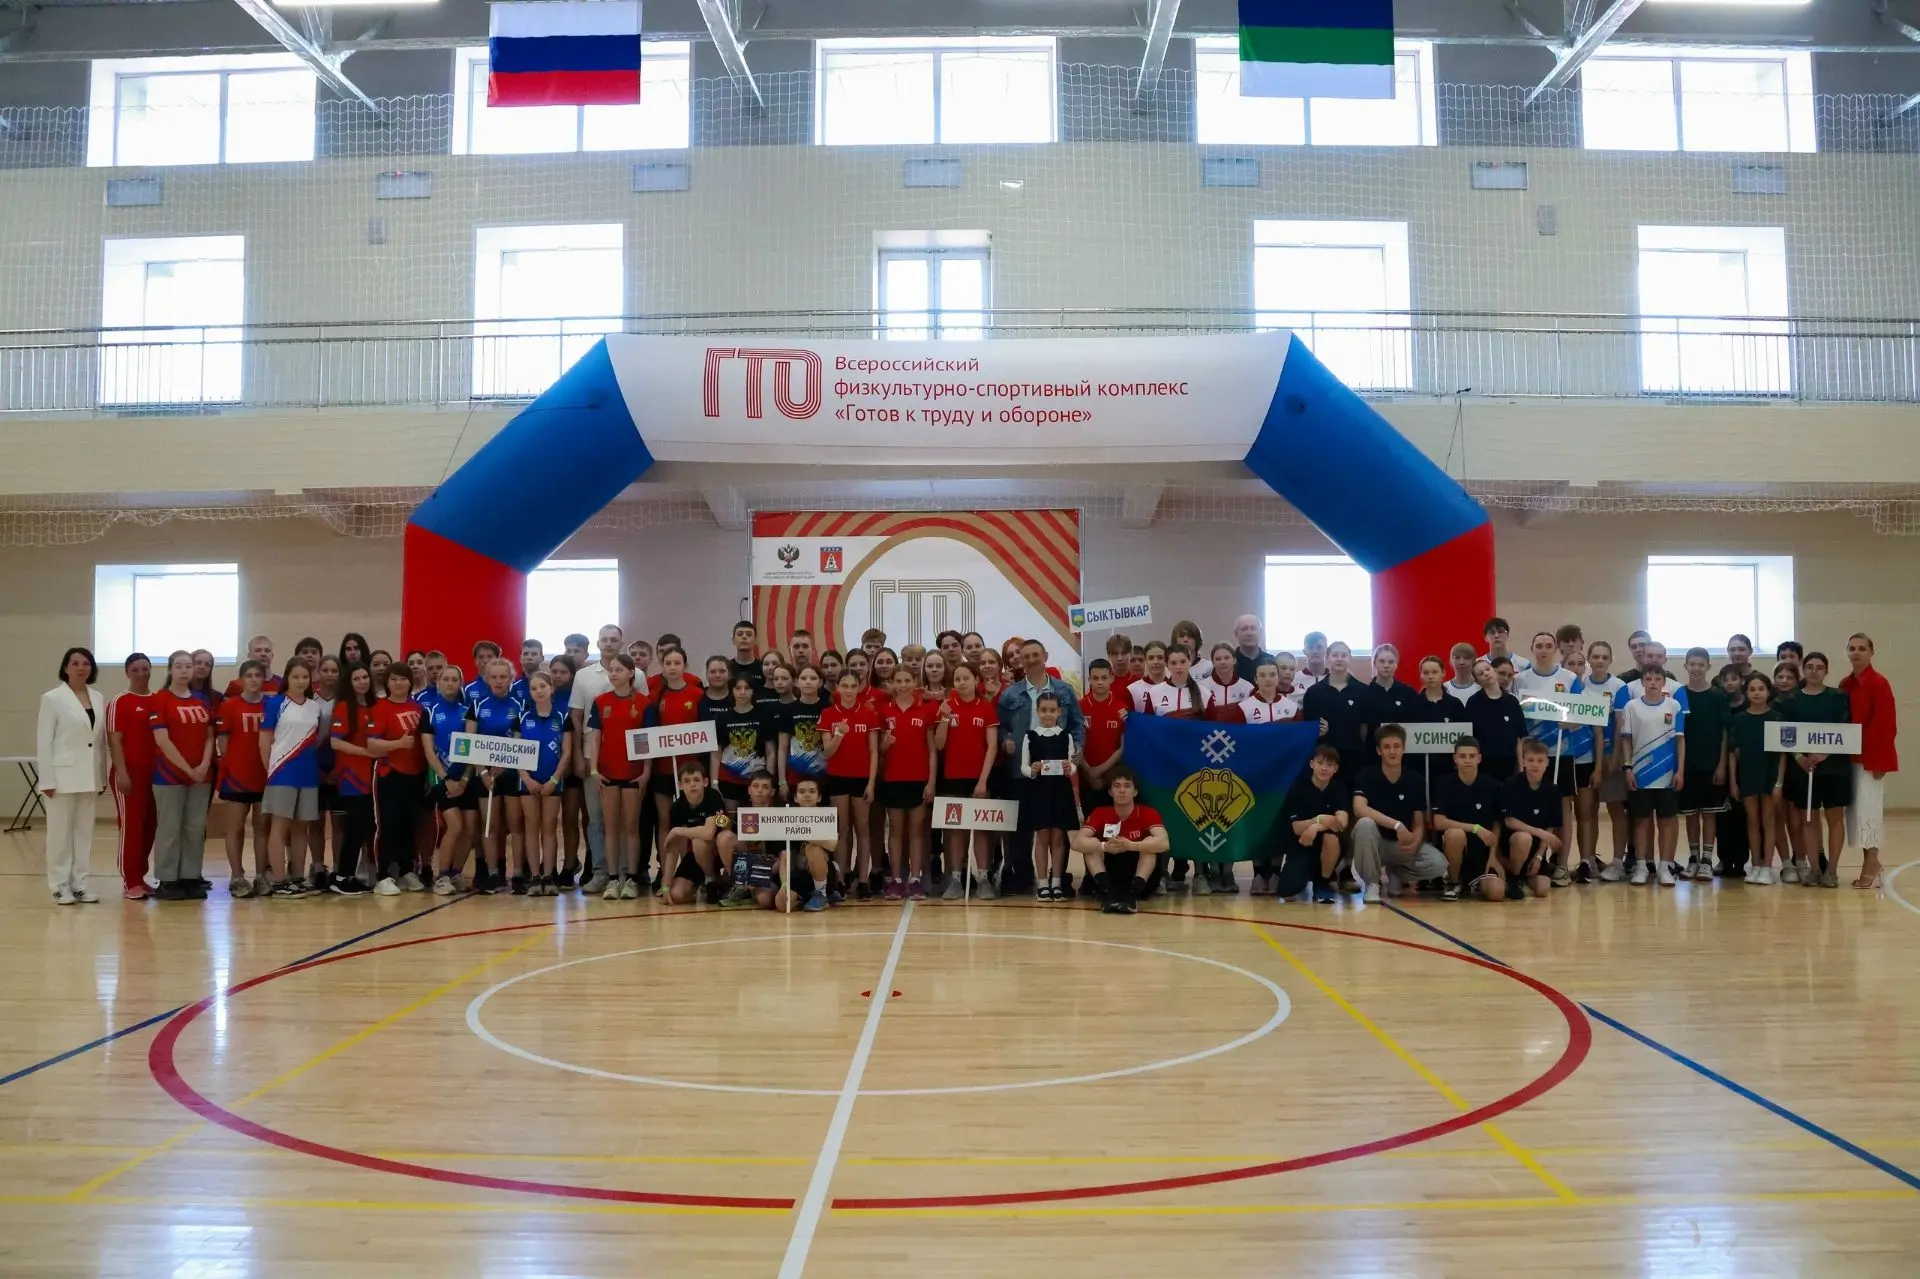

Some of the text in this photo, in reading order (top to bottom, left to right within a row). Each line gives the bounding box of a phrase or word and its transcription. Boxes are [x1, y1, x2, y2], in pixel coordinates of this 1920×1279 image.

[835, 356, 980, 373] Всероссийский
[703, 347, 822, 420] ГТО
[834, 378, 1189, 401] физкультурно-спортивный комплекс
[835, 404, 1092, 426] «Готов к труду и обороне»
[1086, 604, 1149, 623] СЫКТЫВКАР
[176, 705, 210, 724] ГТО
[911, 717, 923, 727] ГТО
[972, 717, 984, 727] ГТО
[854, 723, 867, 733] ГТО
[1106, 720, 1118, 729] ГТО
[658, 730, 709, 748] ПЕЧОРА
[1807, 732, 1844, 746] ИНТА
[474, 739, 537, 755] СЫСОЛЬСКИЙ
[489, 753, 519, 765] РАЙОН
[761, 813, 835, 824] КНЯЖПОГОСТСКИЙ
[974, 808, 1004, 823] УХТА
[785, 825, 811, 835] РАЙОН
